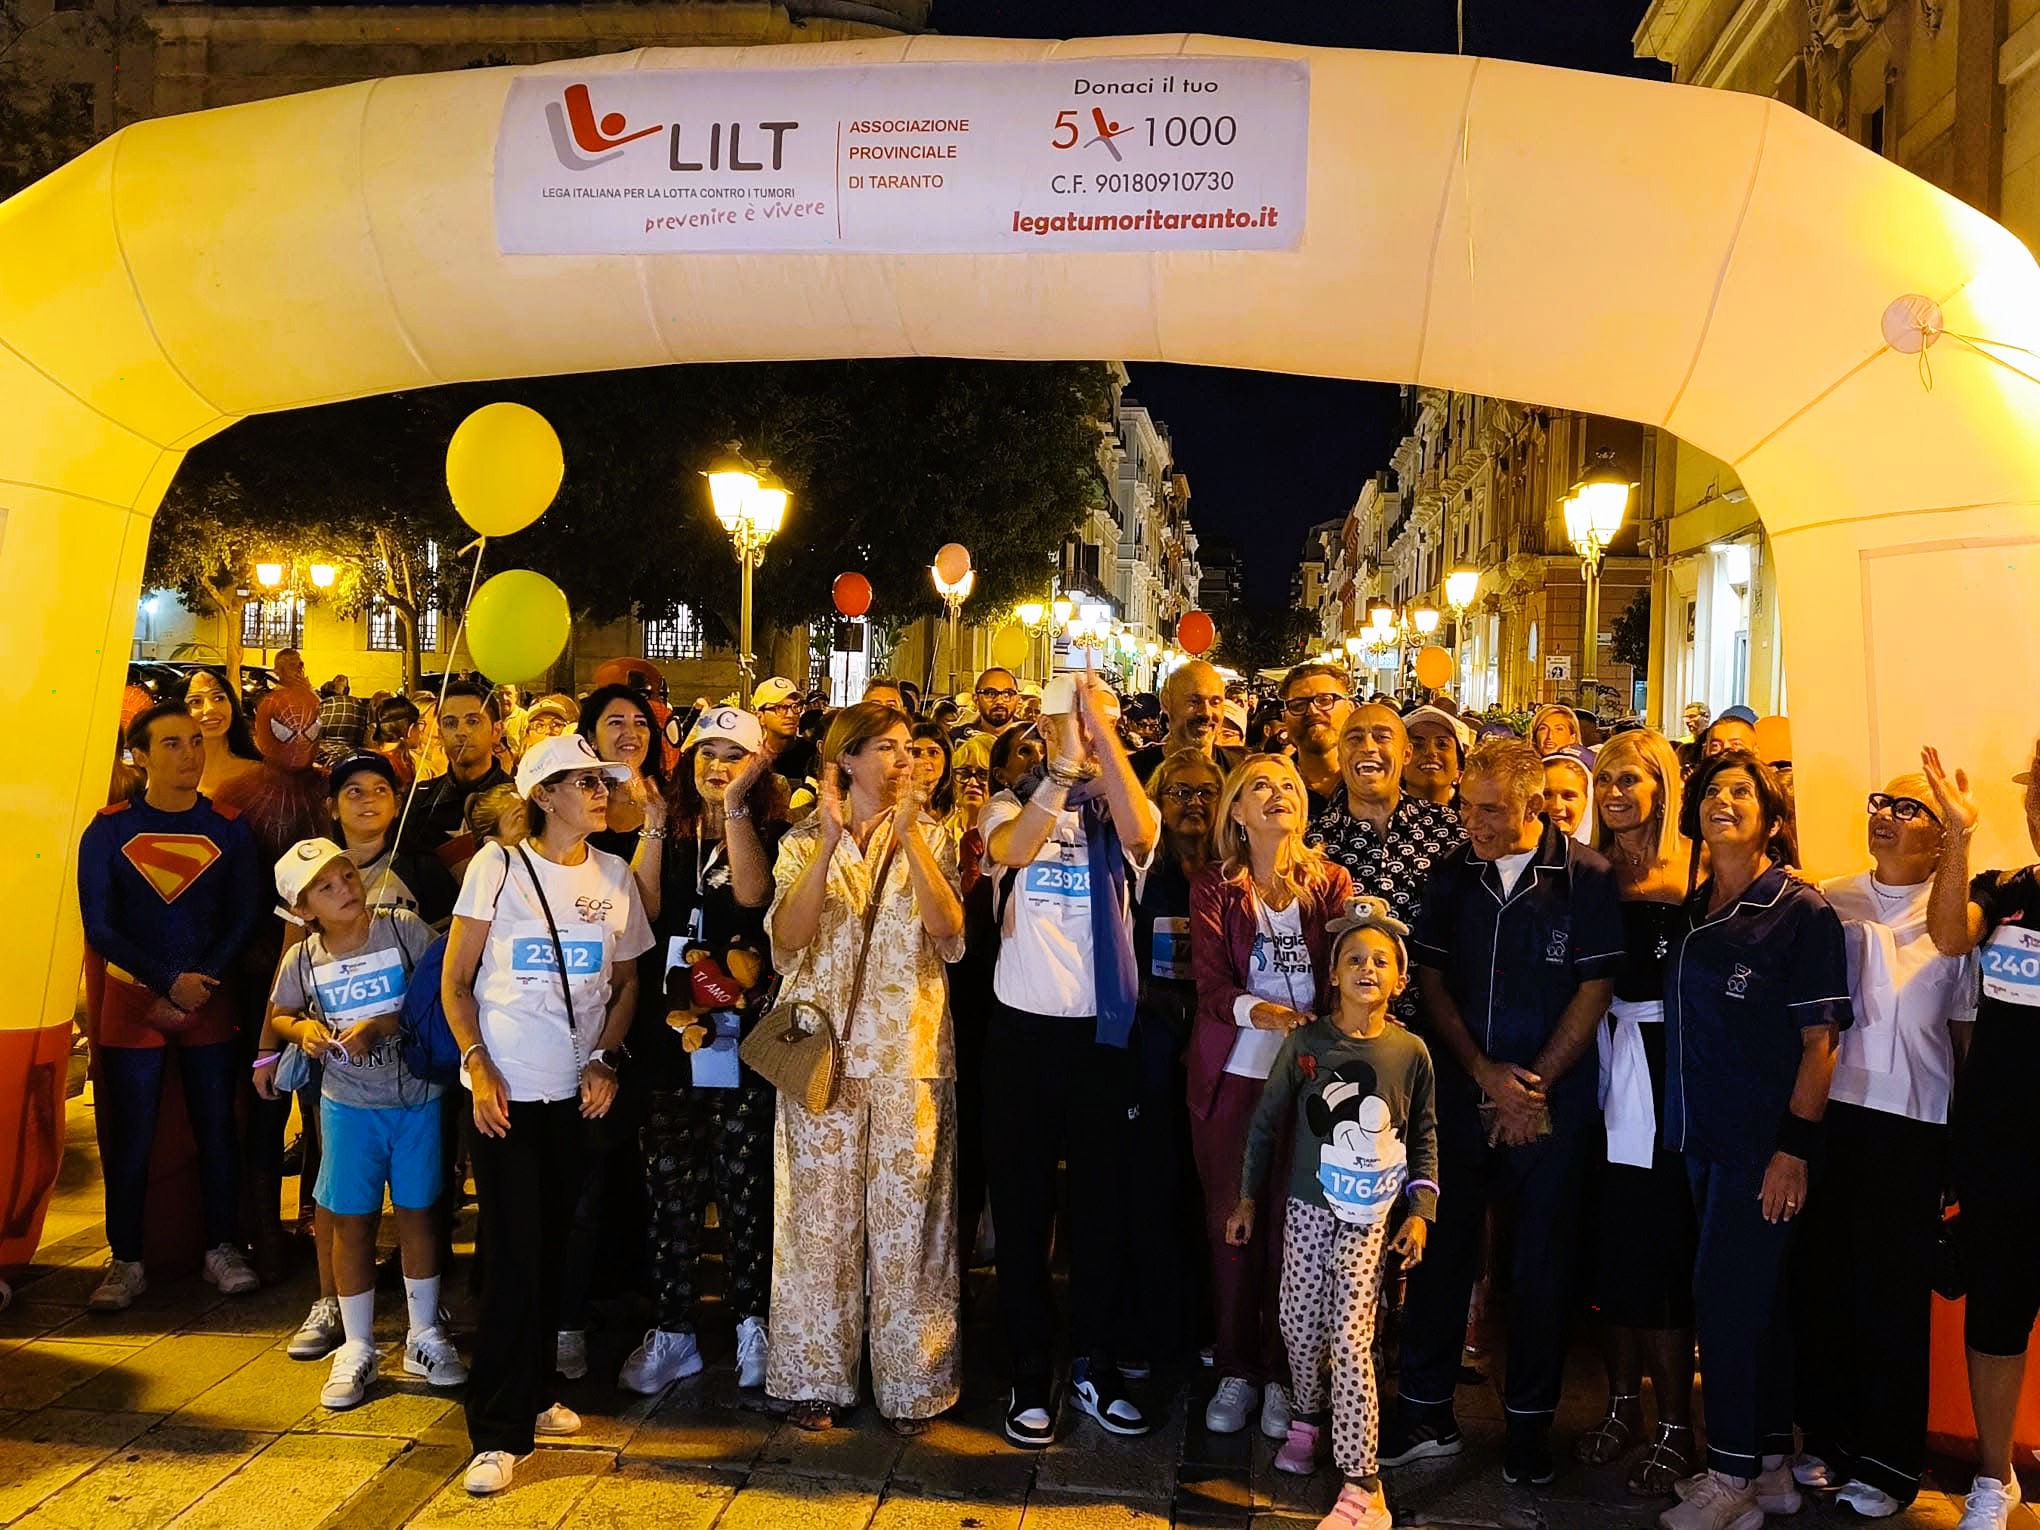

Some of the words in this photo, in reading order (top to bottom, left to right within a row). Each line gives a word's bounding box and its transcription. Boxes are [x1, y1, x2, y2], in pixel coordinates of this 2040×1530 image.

[1074, 77, 1154, 95] Donaci
[1163, 76, 1174, 94] il
[1182, 78, 1219, 94] tuo
[848, 118, 970, 134] ASSOCIAZIONE
[1051, 110, 1079, 150] 5
[1144, 115, 1237, 147] 1000
[669, 122, 799, 171] LILT
[848, 144, 958, 160] PROVINCIALE
[542, 187, 571, 199] LEGA
[573, 187, 622, 199] ITALIANA
[623, 187, 646, 199] PER
[647, 187, 662, 199] LA
[663, 187, 698, 199] LOTTA
[699, 187, 746, 199] CONTRO
[752, 187, 796, 199] TUMORI
[848, 176, 865, 190] DI
[869, 174, 944, 190] TARANTO
[1051, 174, 1087, 195] C.F.
[1095, 170, 1234, 194] 90180910730
[645, 206, 737, 233] prevenire
[744, 205, 756, 222] è
[763, 200, 825, 220] vivere
[1012, 206, 1279, 236] legatumoritaranto.it
[574, 895, 614, 911] EOS
[526, 944, 589, 968] 2312
[1987, 950, 2040, 978] 240
[324, 975, 391, 1007] 17631
[693, 971, 708, 983] TI
[704, 983, 732, 1003] AMO
[1331, 1171, 1399, 1199] 17646
